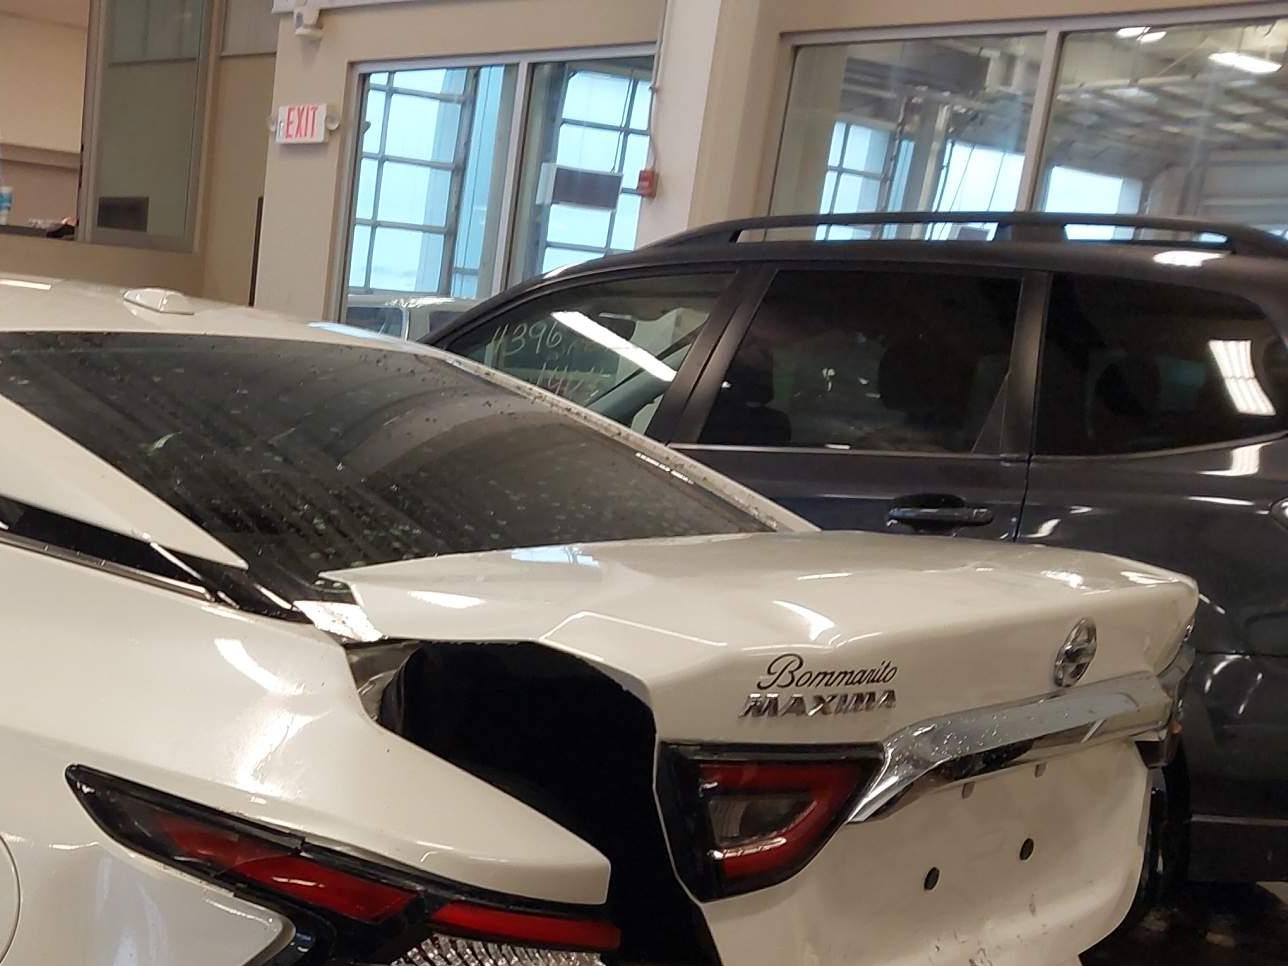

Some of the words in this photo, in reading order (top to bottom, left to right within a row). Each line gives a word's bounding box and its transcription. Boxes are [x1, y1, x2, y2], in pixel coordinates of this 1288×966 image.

[285, 105, 319, 138] EXIT
[756, 653, 898, 690] Bommarito
[738, 689, 897, 718] MAXIMA
